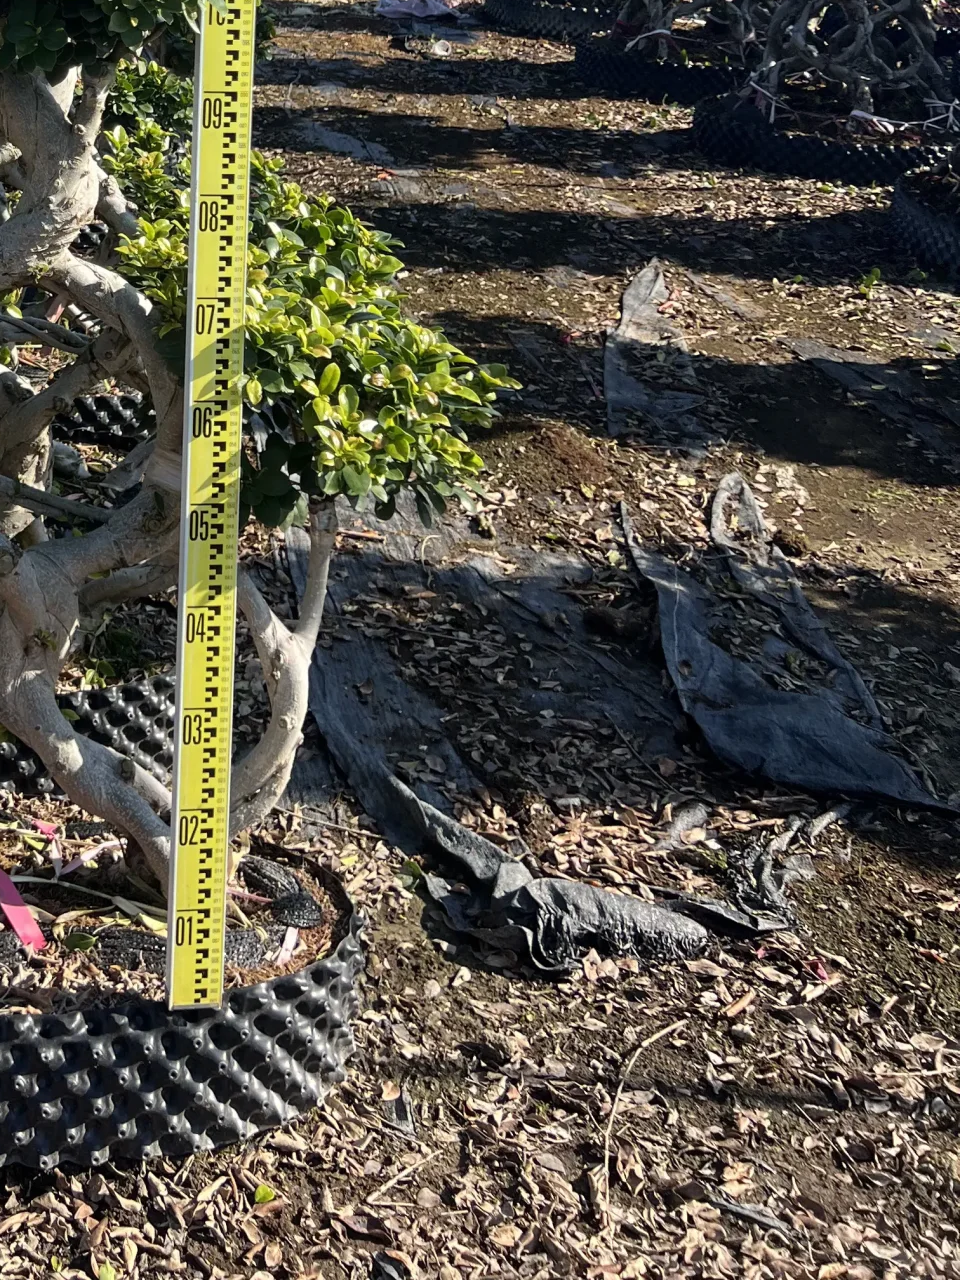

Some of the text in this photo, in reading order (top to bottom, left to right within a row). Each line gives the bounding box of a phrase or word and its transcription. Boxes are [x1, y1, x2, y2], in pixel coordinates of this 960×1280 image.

[203, 98, 222, 129] 09
[199, 201, 218, 232] 08
[196, 304, 215, 335] 07
[193, 407, 212, 438] 06
[189, 511, 209, 541] 05
[186, 613, 205, 643] 04
[183, 715, 202, 745] 03
[179, 815, 199, 846] 02
[176, 916, 193, 946] 01
